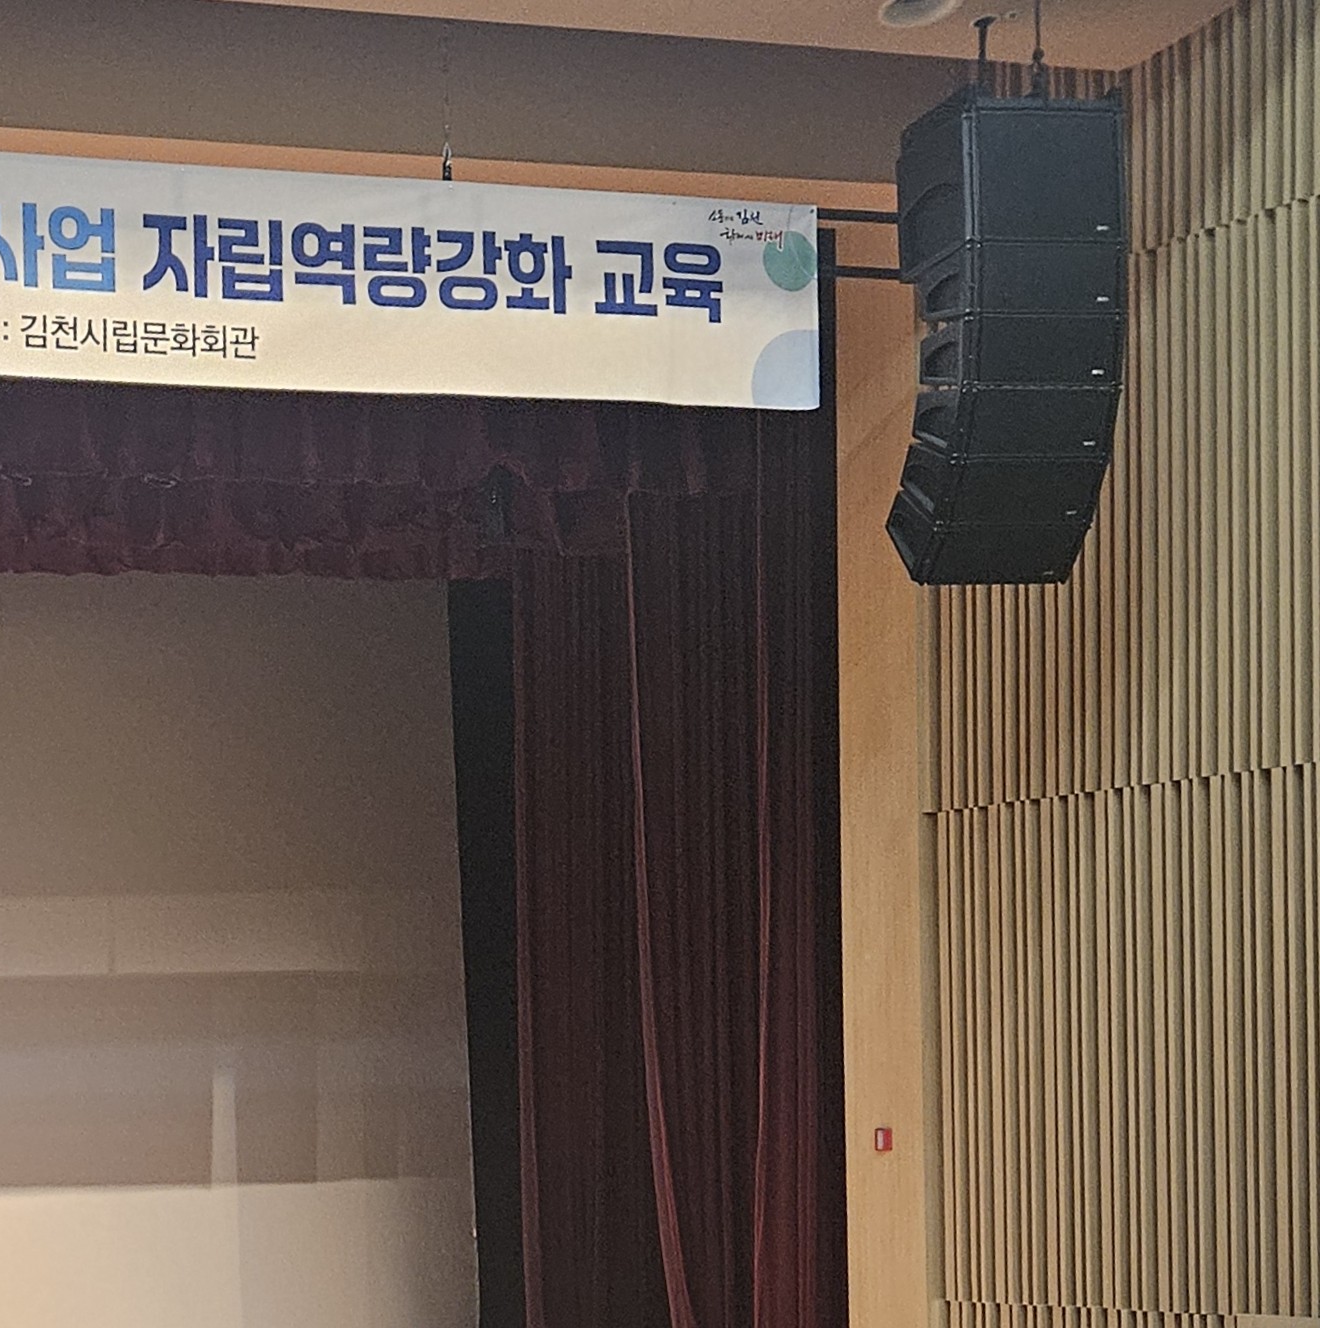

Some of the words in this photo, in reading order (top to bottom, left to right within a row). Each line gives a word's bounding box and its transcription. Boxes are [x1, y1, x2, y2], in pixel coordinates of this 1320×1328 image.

[142, 213, 573, 315] 자립역량강화
[594, 239, 724, 324] 교육
[20, 314, 260, 360] 김천시립문화회관
